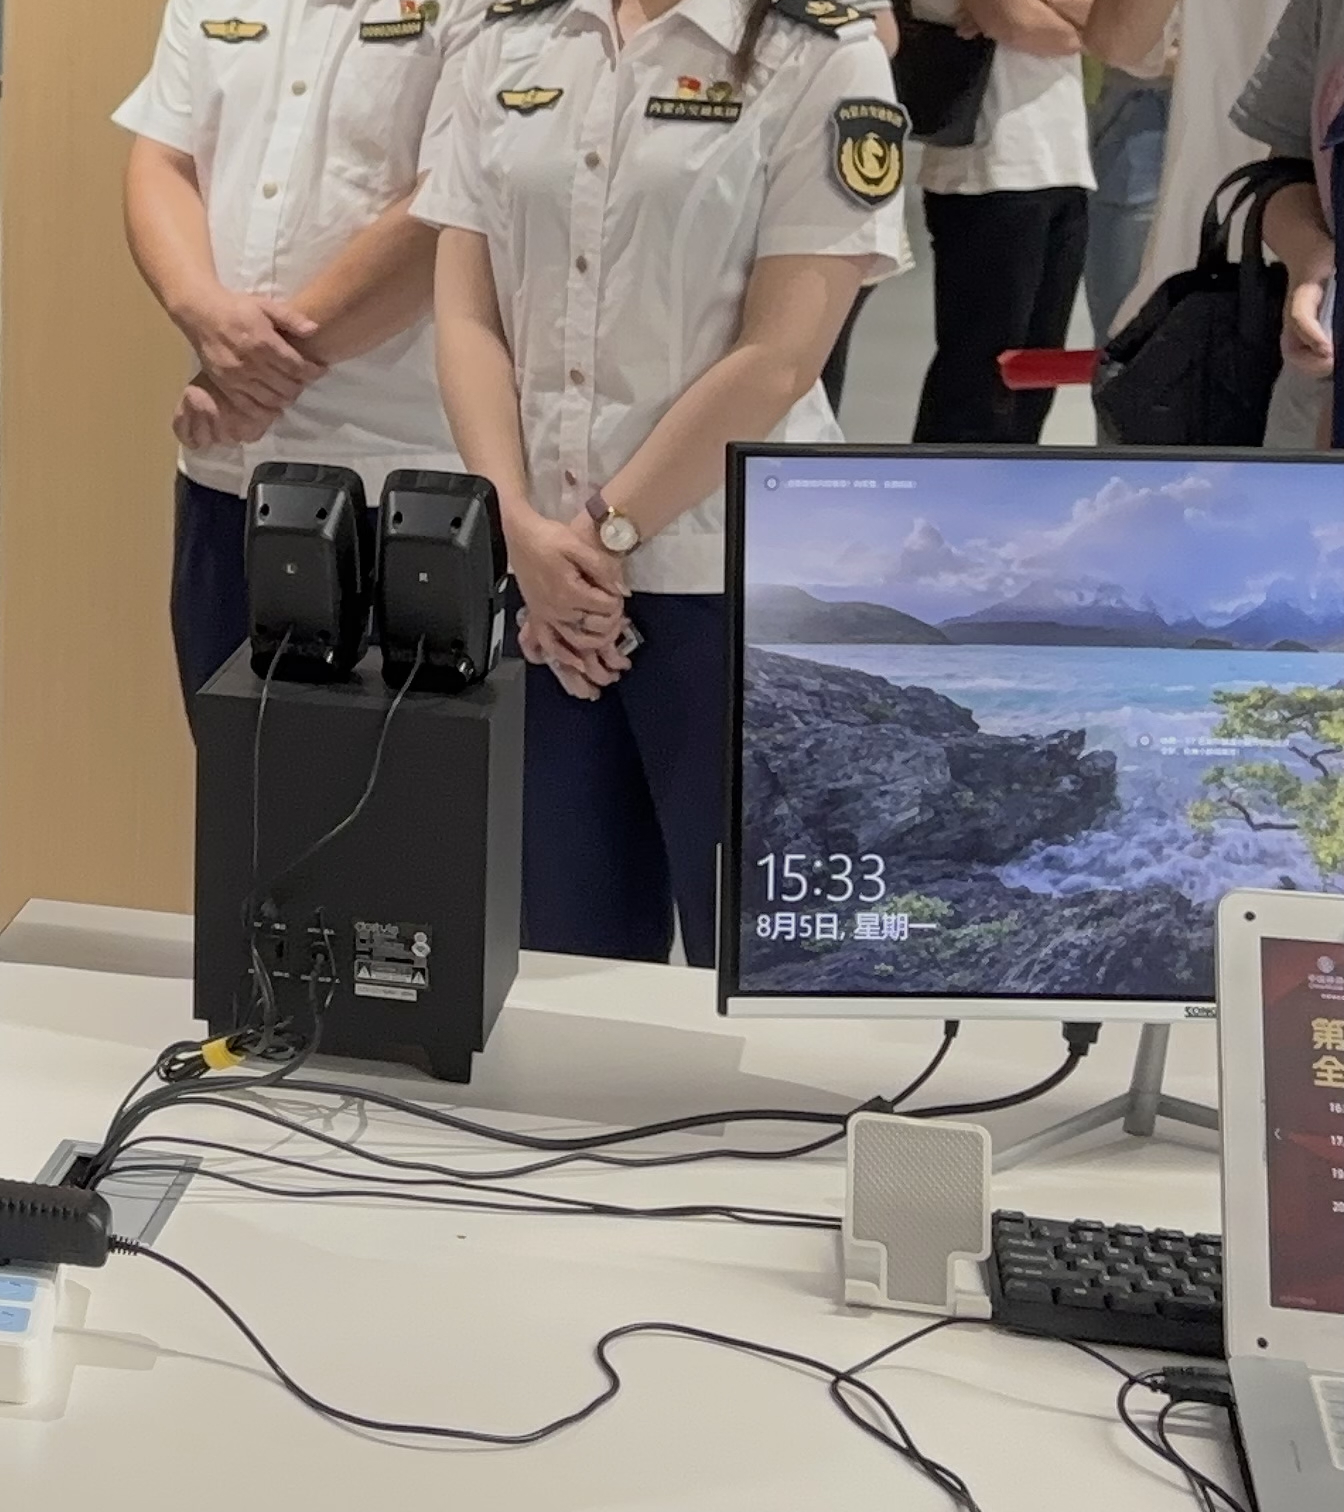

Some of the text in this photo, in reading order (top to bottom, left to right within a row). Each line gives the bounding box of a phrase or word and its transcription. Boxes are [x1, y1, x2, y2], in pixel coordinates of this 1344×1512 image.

[757, 852, 887, 902] 15:33
[756, 912, 938, 941] 8月5日, 星期一
[1312, 1054, 1344, 1088] 全
